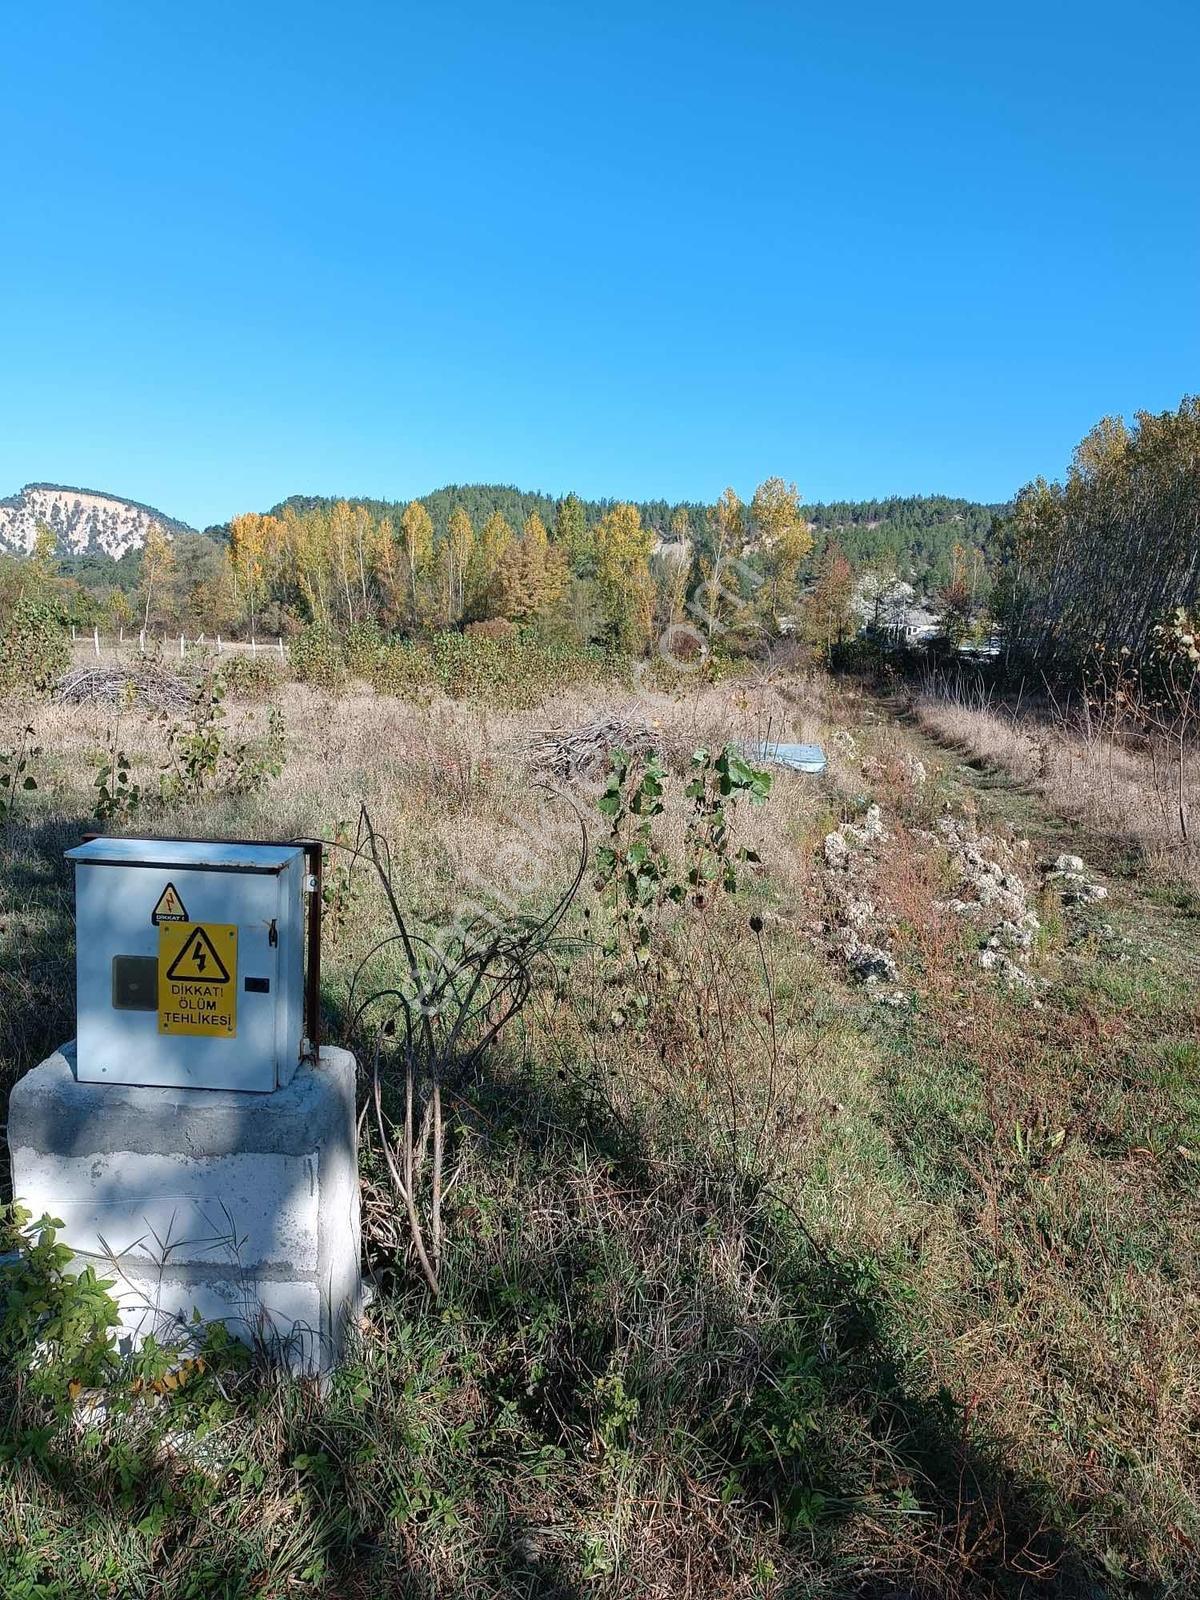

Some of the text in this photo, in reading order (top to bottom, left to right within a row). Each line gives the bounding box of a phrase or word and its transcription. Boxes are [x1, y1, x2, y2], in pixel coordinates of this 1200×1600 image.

[171, 983, 223, 997] DİKKAT!
[179, 997, 217, 1010] ÖLÜM
[164, 1012, 231, 1026] TEHLİKESİ
